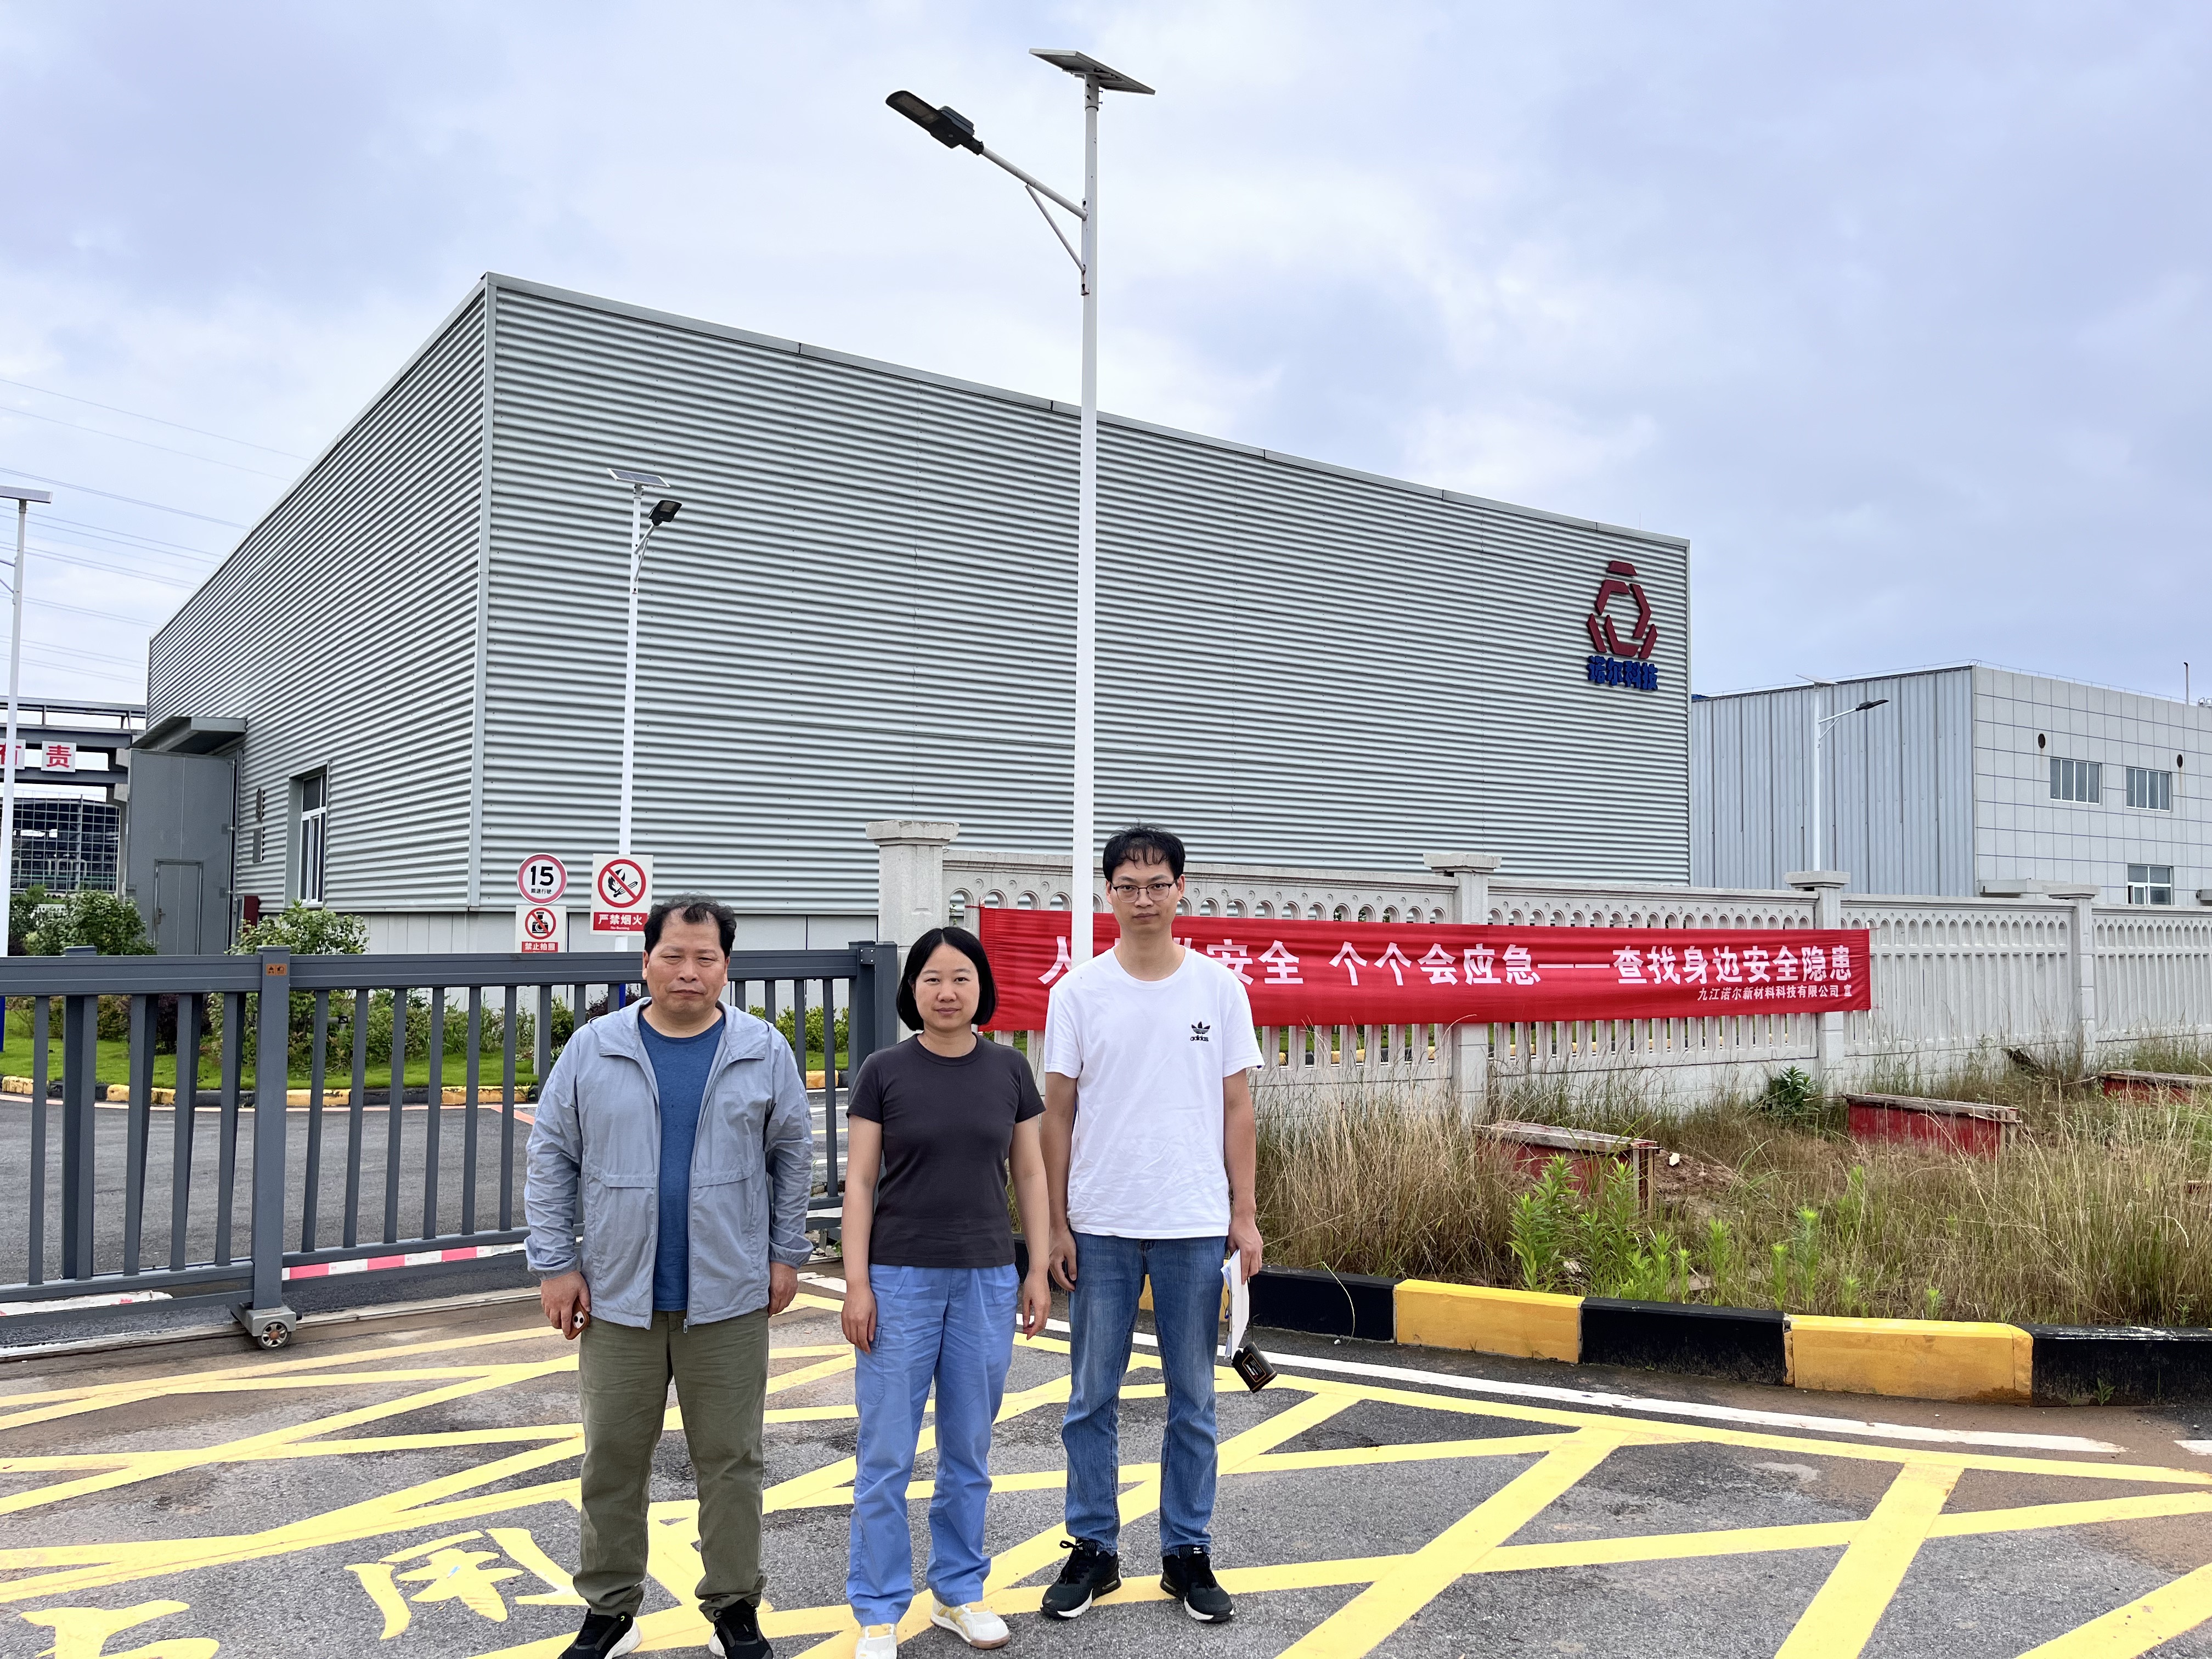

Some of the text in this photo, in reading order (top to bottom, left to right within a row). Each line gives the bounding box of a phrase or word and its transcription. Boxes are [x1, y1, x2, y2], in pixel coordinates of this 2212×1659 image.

[530, 865, 554, 887] 15
[598, 914, 643, 926] 严禁烟火
[524, 942, 556, 951] 禁止拍照
[1037, 936, 1304, 985] 人安全
[1697, 985, 1839, 1001] 九江诺尔新材料科技有限公司
